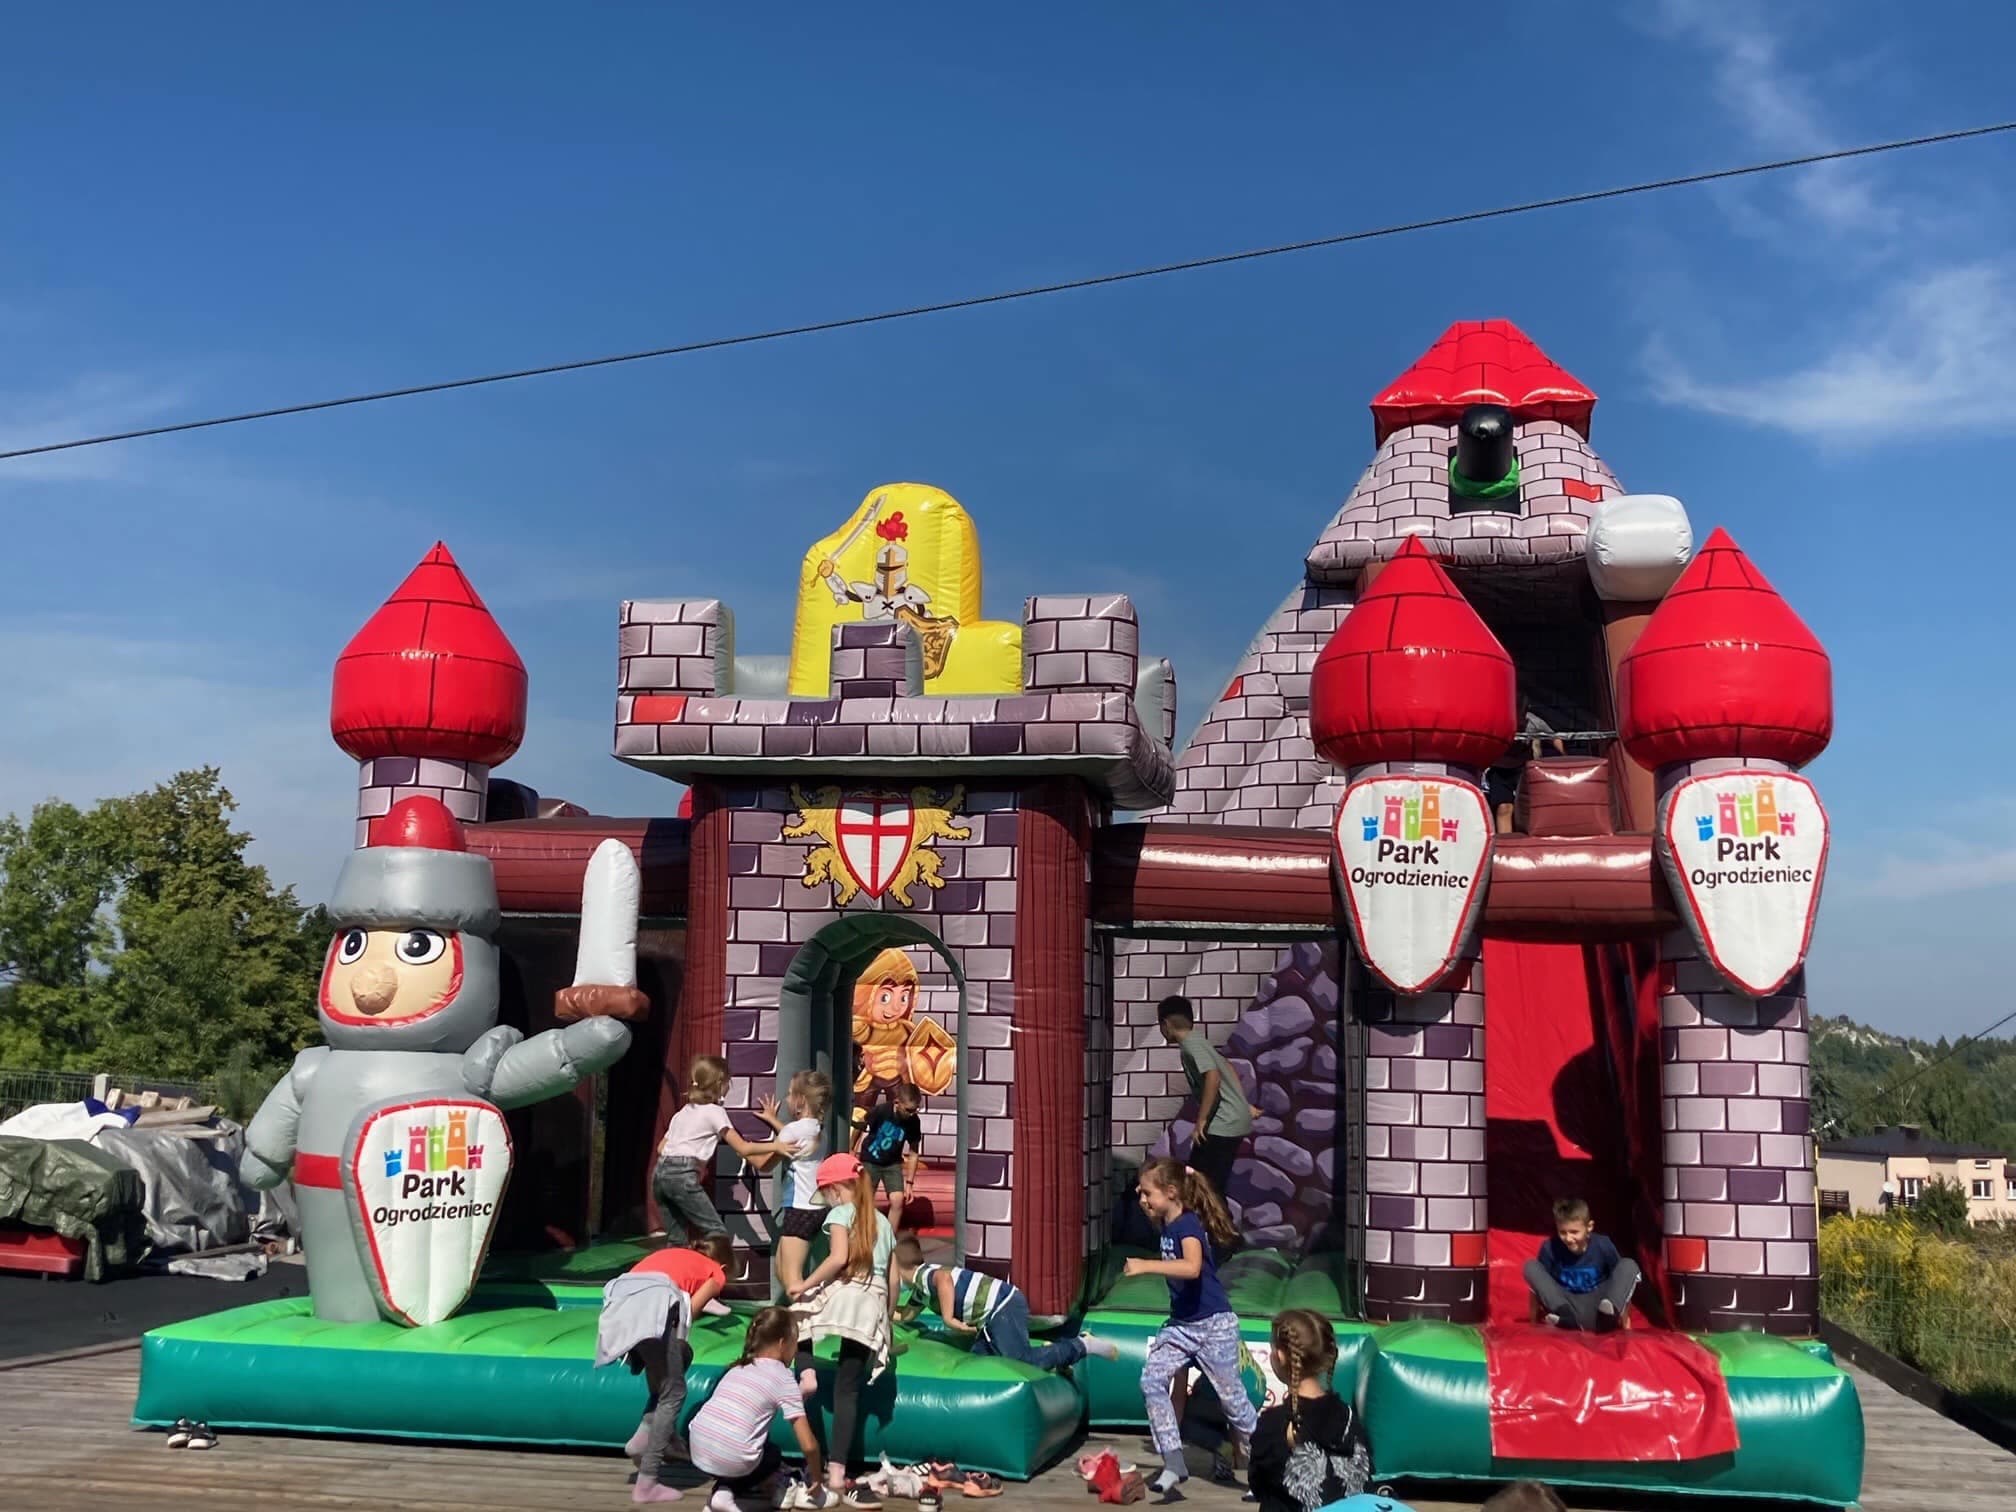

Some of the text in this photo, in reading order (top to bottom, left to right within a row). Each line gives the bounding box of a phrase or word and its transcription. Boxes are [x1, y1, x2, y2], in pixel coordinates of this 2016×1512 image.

[1378, 839, 1439, 865] Park
[1717, 836, 1781, 862] Park
[1351, 867, 1469, 888] Ogrodzieniec
[1691, 866, 1812, 888] Ogrodzieniec
[402, 1171, 466, 1199] Park
[373, 1201, 492, 1226] Ogrodzieniec
